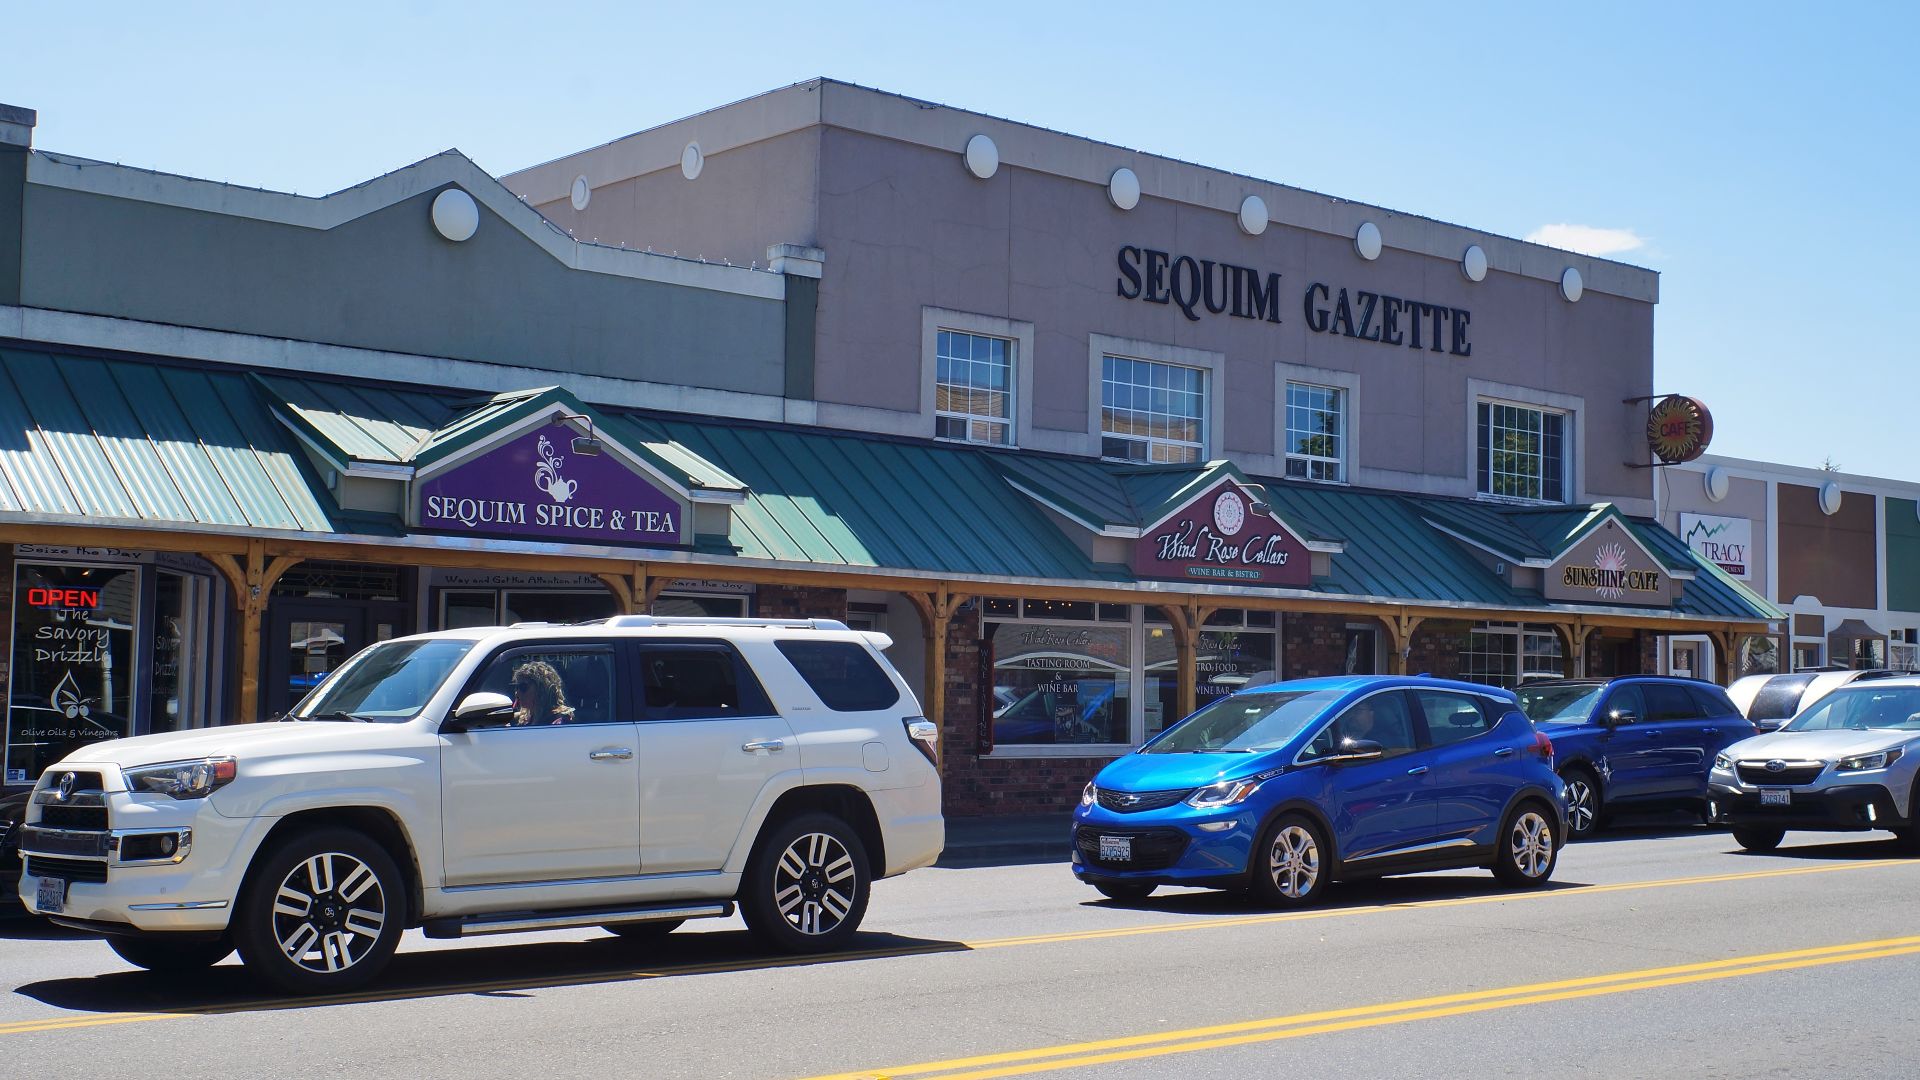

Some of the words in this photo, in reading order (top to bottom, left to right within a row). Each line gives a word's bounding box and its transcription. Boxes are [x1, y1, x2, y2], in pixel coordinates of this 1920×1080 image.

[1117, 245, 1283, 325] SEQUIM
[1304, 282, 1472, 357] GAZETTE
[1660, 421, 1691, 437] CAFE
[427, 495, 526, 527] SEQUIM
[536, 504, 604, 529] SPICE
[610, 509, 626, 531] &
[631, 510, 676, 533] TEA
[1157, 520, 1209, 560] Wind
[1204, 532, 1239, 564] Rose
[1242, 535, 1289, 565] Cellars
[107, 547, 142, 559] Day
[1701, 541, 1745, 562] TRACY
[445, 575, 469, 585] Way
[1190, 567, 1210, 576] WINE
[1212, 568, 1226, 577] BAR
[1227, 570, 1234, 578] &
[1235, 570, 1259, 579] BISTRO
[1563, 566, 1625, 589] SUNSHINE
[1628, 570, 1659, 591] CAFE
[28, 588, 97, 607] OPEN
[57, 607, 89, 621] The
[35, 626, 110, 648] Savory
[35, 644, 109, 662] Drizzle
[1025, 658, 1062, 669] TASTING
[1064, 659, 1090, 669] ROOM
[1215, 663, 1238, 672] FOOD
[1055, 671, 1062, 681] &
[1037, 683, 1061, 693] WINE
[1063, 683, 1079, 693] BAR
[1216, 686, 1230, 695] BAR
[21, 727, 45, 737] Olive
[47, 727, 67, 737] Oils
